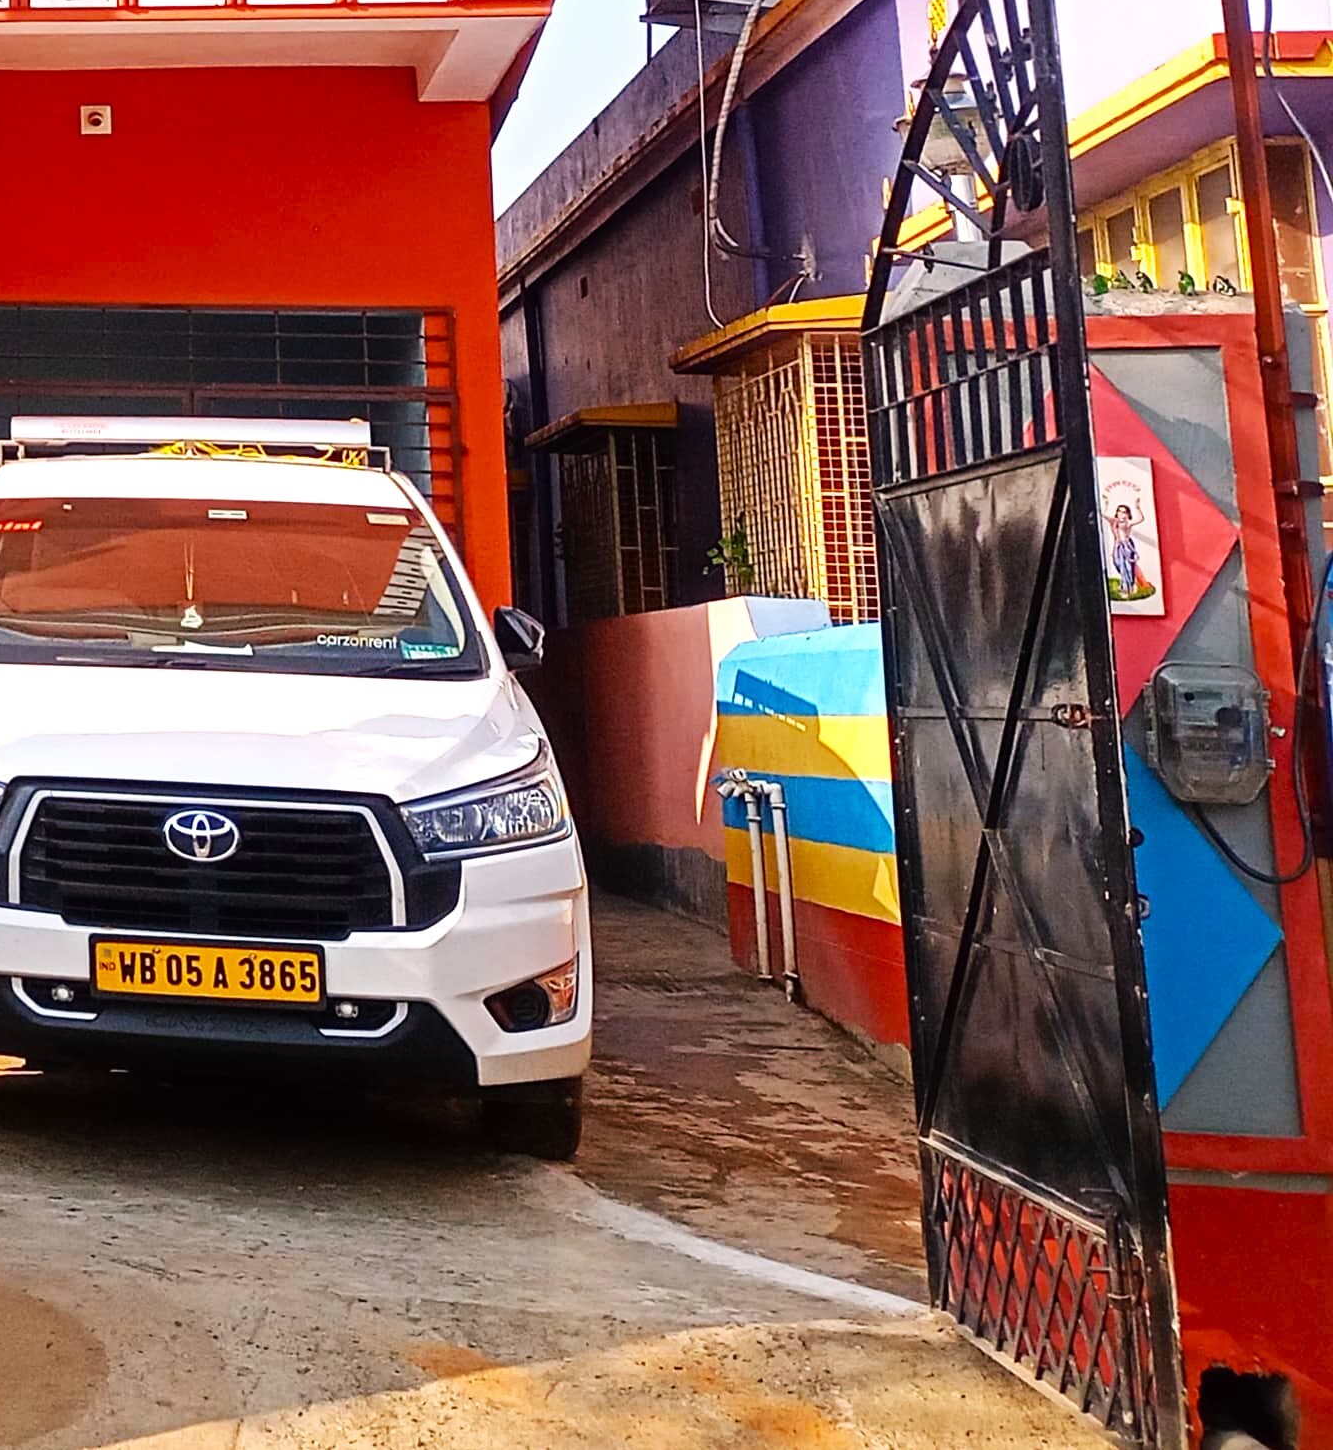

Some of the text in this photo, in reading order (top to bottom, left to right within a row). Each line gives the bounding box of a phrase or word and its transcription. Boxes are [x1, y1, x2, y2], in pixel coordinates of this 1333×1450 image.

[316, 633, 398, 650] carzonrent
[99, 961, 116, 971] IND
[119, 951, 317, 993] WB 05 A 3865
